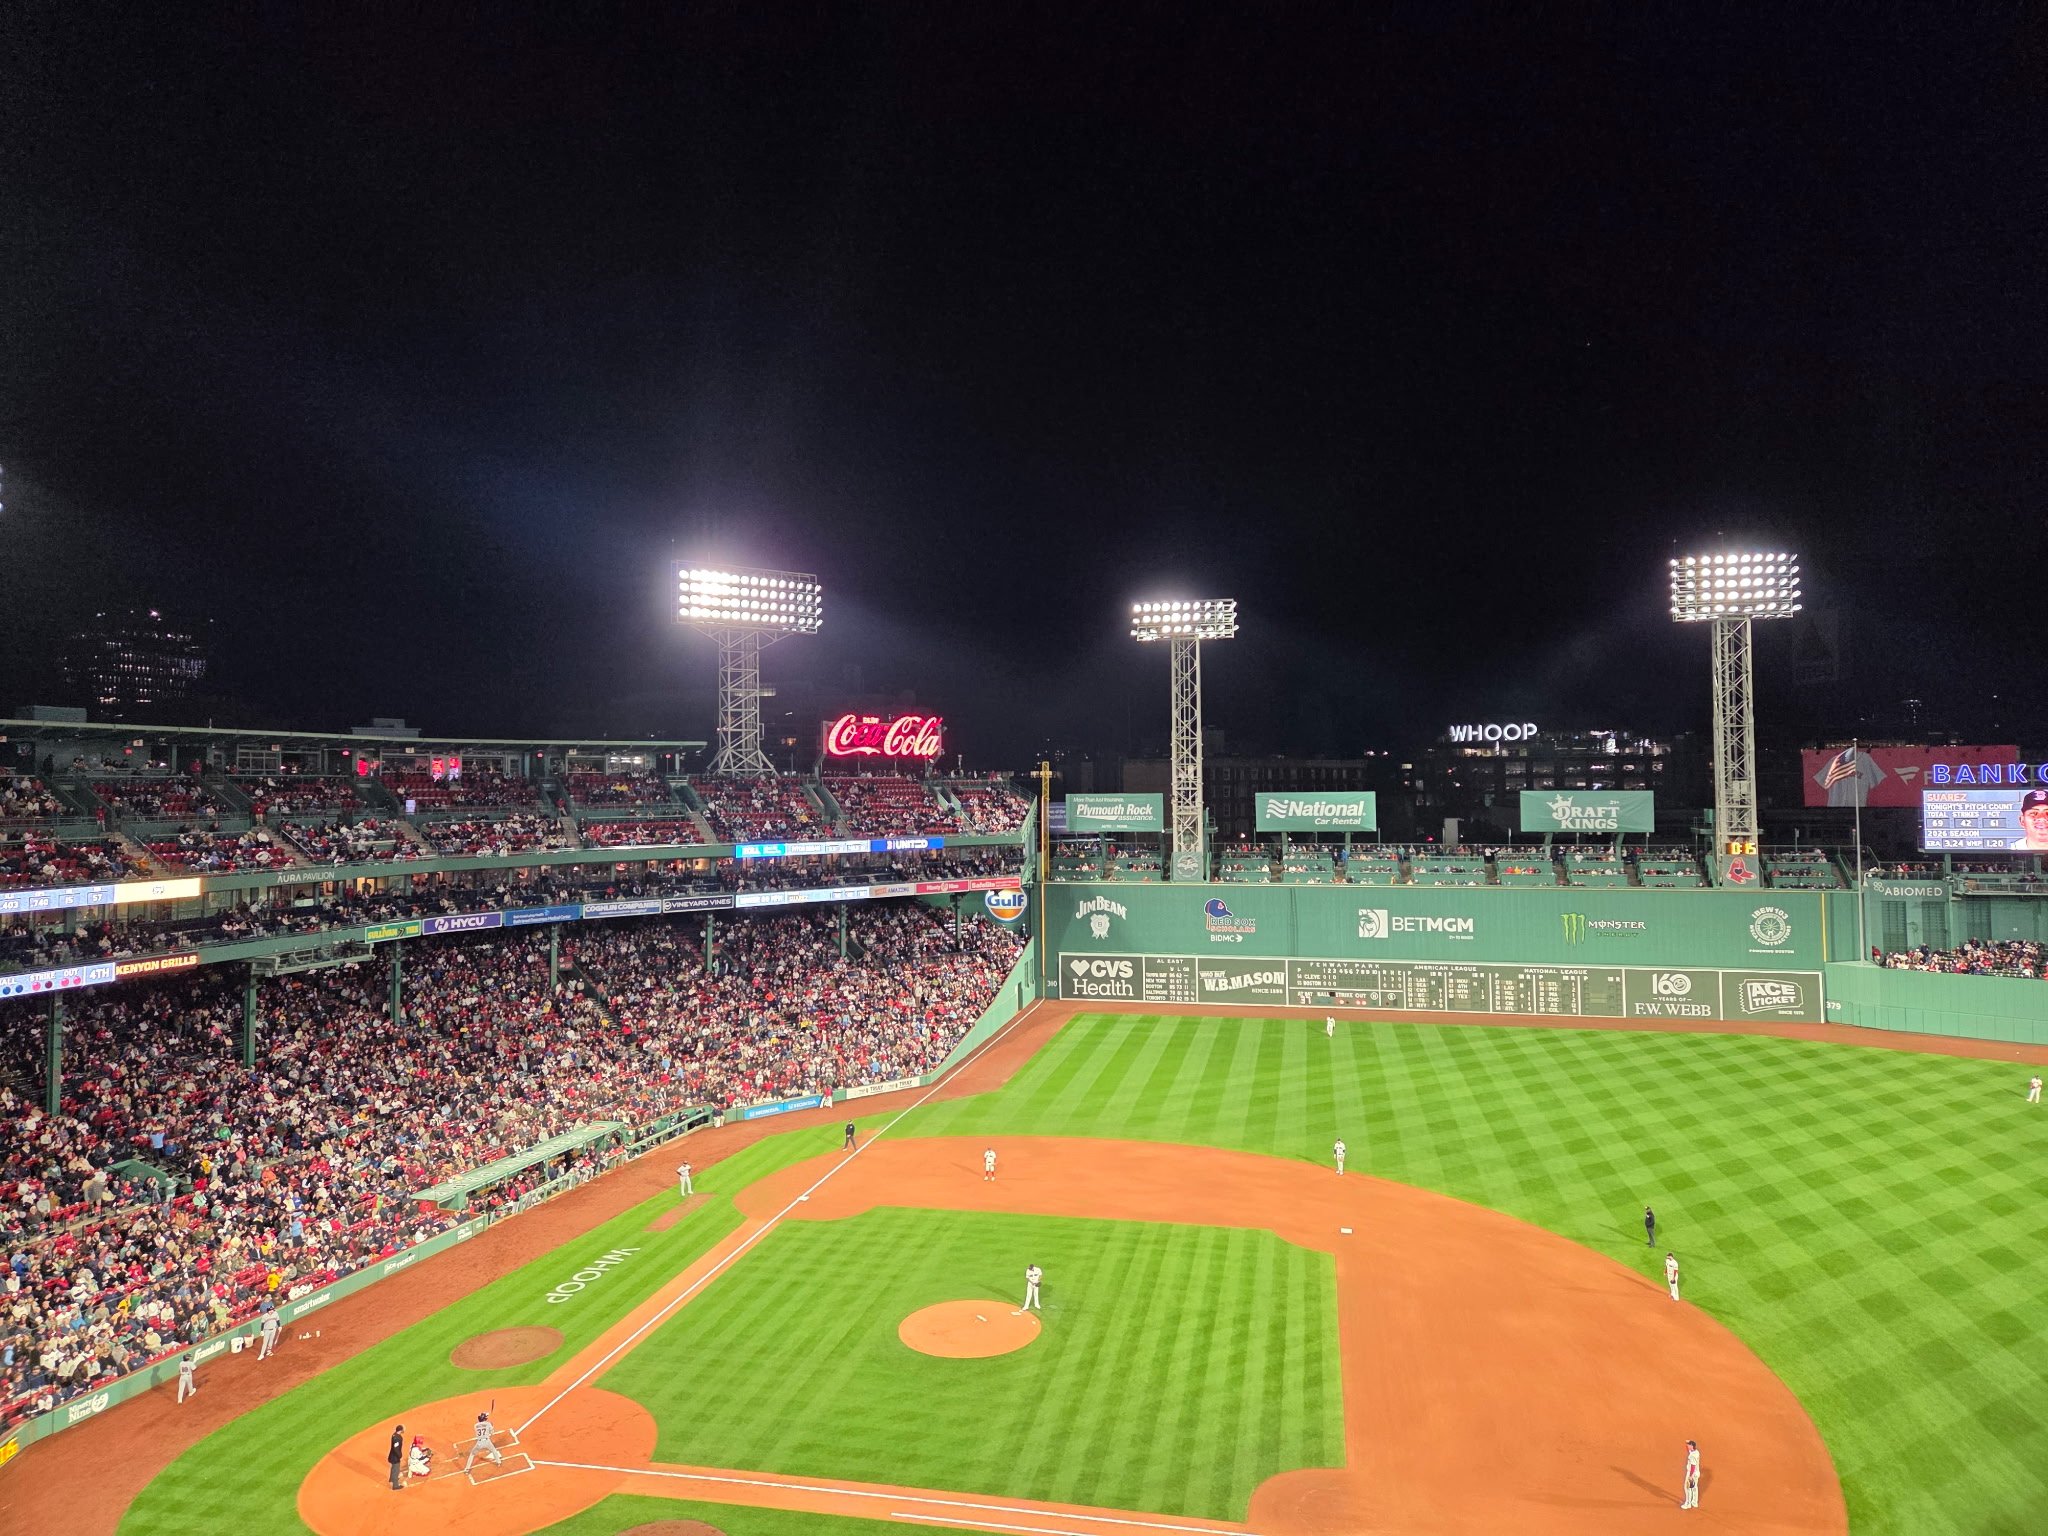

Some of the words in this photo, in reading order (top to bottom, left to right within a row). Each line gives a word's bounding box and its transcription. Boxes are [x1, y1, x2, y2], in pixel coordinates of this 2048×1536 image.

[1449, 723, 1538, 742] WHOOP
[1933, 763, 2028, 784] BANK
[1927, 793, 1967, 801] SUAREZ
[1077, 804, 1124, 816] Plymouth
[1127, 803, 1153, 815] Rock
[1288, 801, 1364, 817] National
[1552, 805, 1620, 821] DRAFT
[1332, 817, 1361, 825] Rental
[1560, 819, 1618, 829] KINGS
[895, 839, 929, 850] UNITED
[277, 871, 302, 884] AURA
[302, 870, 335, 882] PAVILION
[1884, 887, 1943, 897] ABIOMED
[671, 900, 709, 908] VINEYARD
[987, 894, 1025, 907] Gulf
[585, 903, 618, 912] COGHLIN
[1075, 901, 1097, 920] JIM
[1096, 895, 1128, 920] BEAM
[1751, 906, 1774, 919] IBEW
[1774, 908, 1789, 919] 103
[451, 917, 485, 928] HYCU
[1211, 917, 1232, 926] RED
[1234, 918, 1256, 927] SOX
[1392, 917, 1473, 933] BETMGM
[367, 928, 397, 939] SULLIVAN
[1210, 934, 1235, 942] BIDMC
[115, 961, 160, 975] KENYON
[160, 955, 197, 969] GRILLS
[1090, 960, 1134, 978] CVS
[29, 972, 57, 982] STRIKE
[64, 968, 79, 977] OUT
[90, 968, 109, 979] 4TH
[1072, 978, 1134, 997] Health
[1751, 982, 1795, 997] ACE
[1752, 995, 1797, 1007] TICKET
[1826, 1001, 1842, 1010] 379
[1634, 1002, 1662, 1015] F.W.
[1667, 1003, 1712, 1017] WEBB
[793, 1099, 817, 1109] HONDA
[755, 1106, 779, 1116] HONDA
[545, 1247, 641, 1304] WHOOP
[293, 1292, 331, 1316] smartwater
[68, 1398, 93, 1413] Ninety
[68, 1406, 92, 1423] Nine
[476, 1428, 487, 1437] 37
